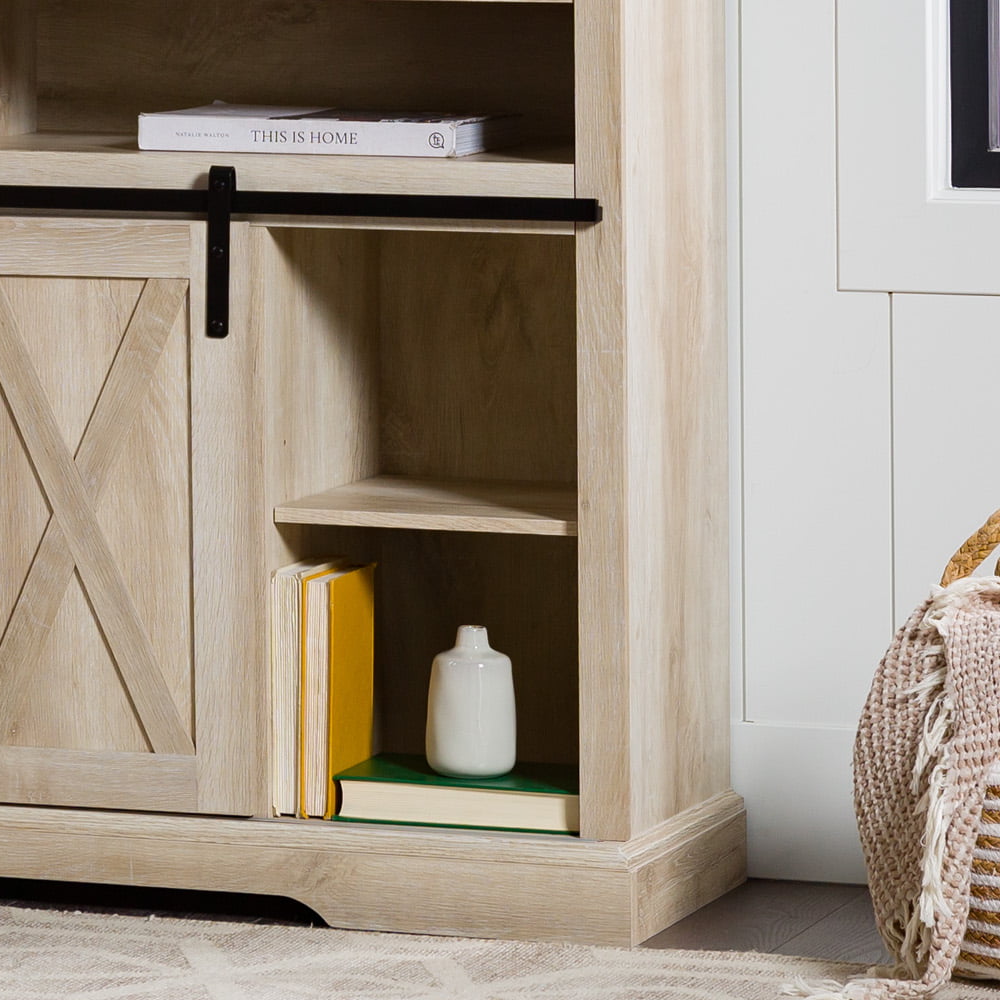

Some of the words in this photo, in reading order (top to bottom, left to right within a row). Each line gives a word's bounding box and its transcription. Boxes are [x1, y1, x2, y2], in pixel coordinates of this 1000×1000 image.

[251, 130, 287, 143] THIS
[292, 131, 305, 144] IS
[310, 131, 358, 145] HOME
